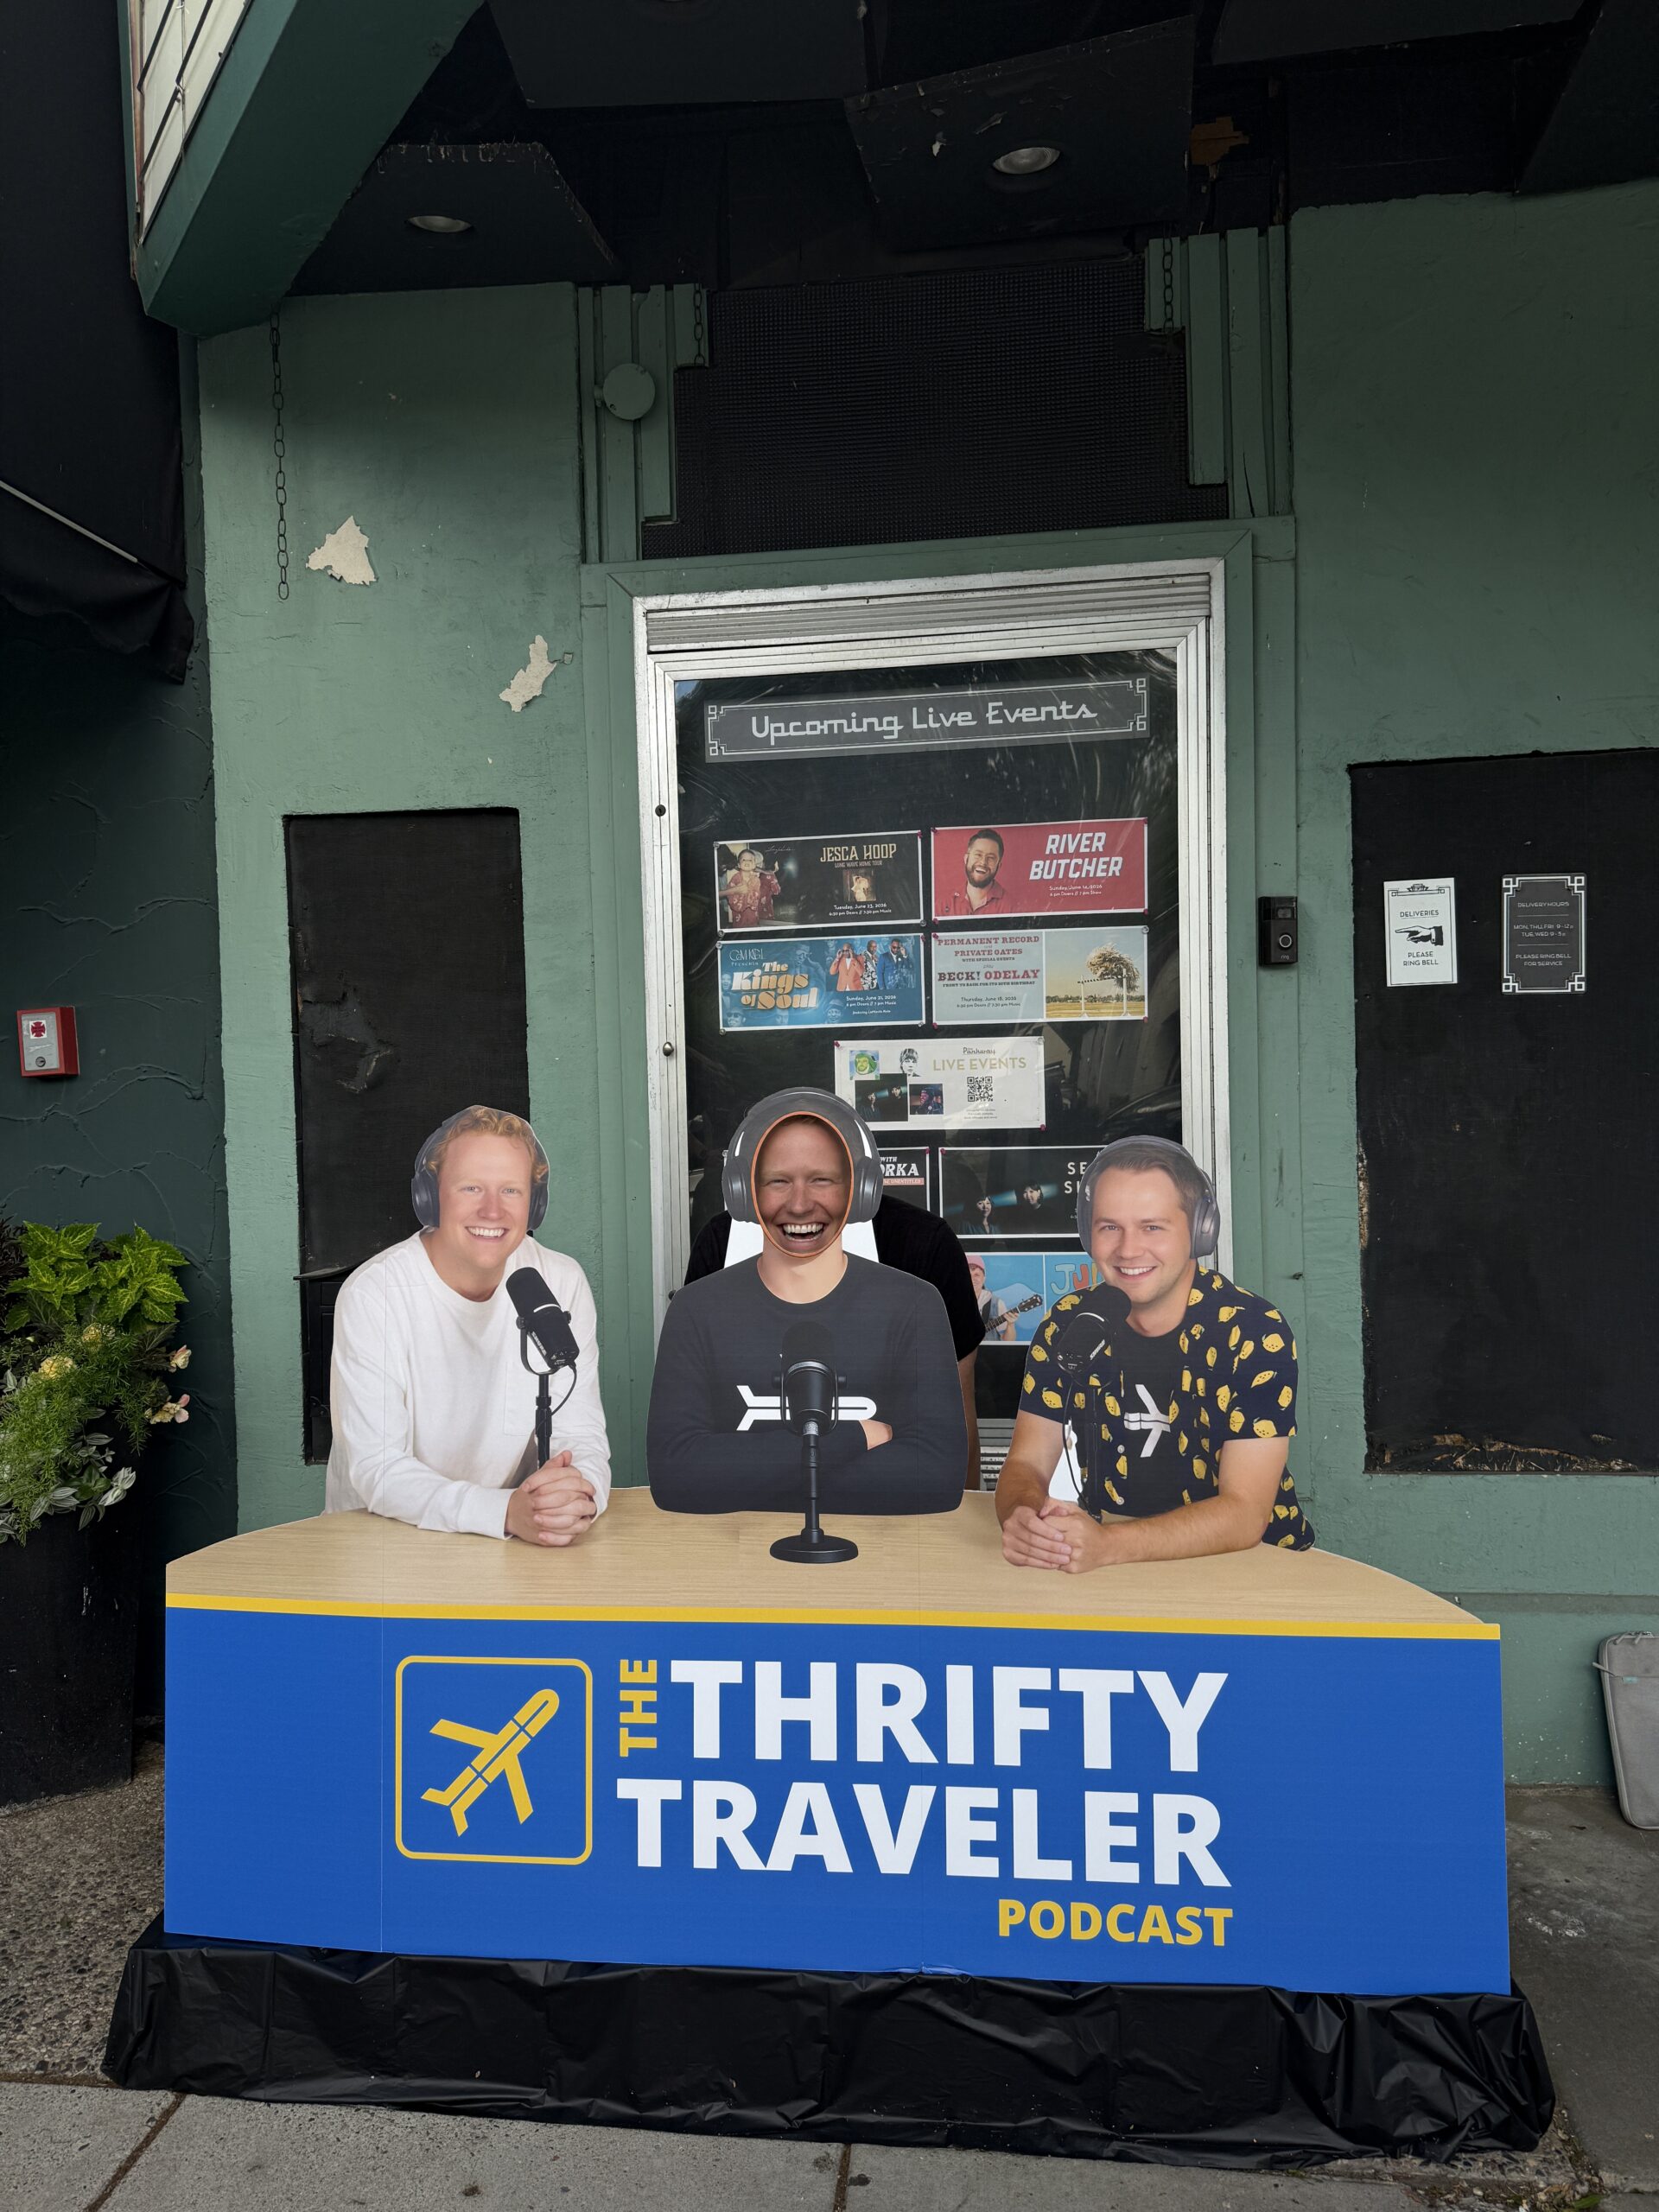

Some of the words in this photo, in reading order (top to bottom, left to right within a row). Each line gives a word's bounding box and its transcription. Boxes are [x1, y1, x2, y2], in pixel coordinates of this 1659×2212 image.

[752, 712, 904, 746] Upcoming
[912, 707, 977, 729] Live
[986, 701, 1097, 724] Events
[820, 846, 859, 862] JESCA
[864, 843, 897, 860] HOOP
[1045, 832, 1106, 855] RIVER
[1029, 856, 1123, 880] BUTCHER
[938, 938, 1000, 946] PERMANENT
[762, 961, 788, 972] The
[938, 971, 981, 982] BECK!
[984, 969, 1040, 980] ODELAY
[731, 969, 809, 995] Kings
[741, 995, 756, 1007] of
[757, 988, 818, 1009] Soul
[933, 1059, 965, 1071] LIVE
[969, 1058, 1027, 1070] EVENTS
[620, 1659, 657, 1758] THE
[671, 1659, 1229, 1772] THRIFTY
[616, 1777, 1231, 1887] TRAVELER
[999, 1899, 1232, 1946] PODCAST
